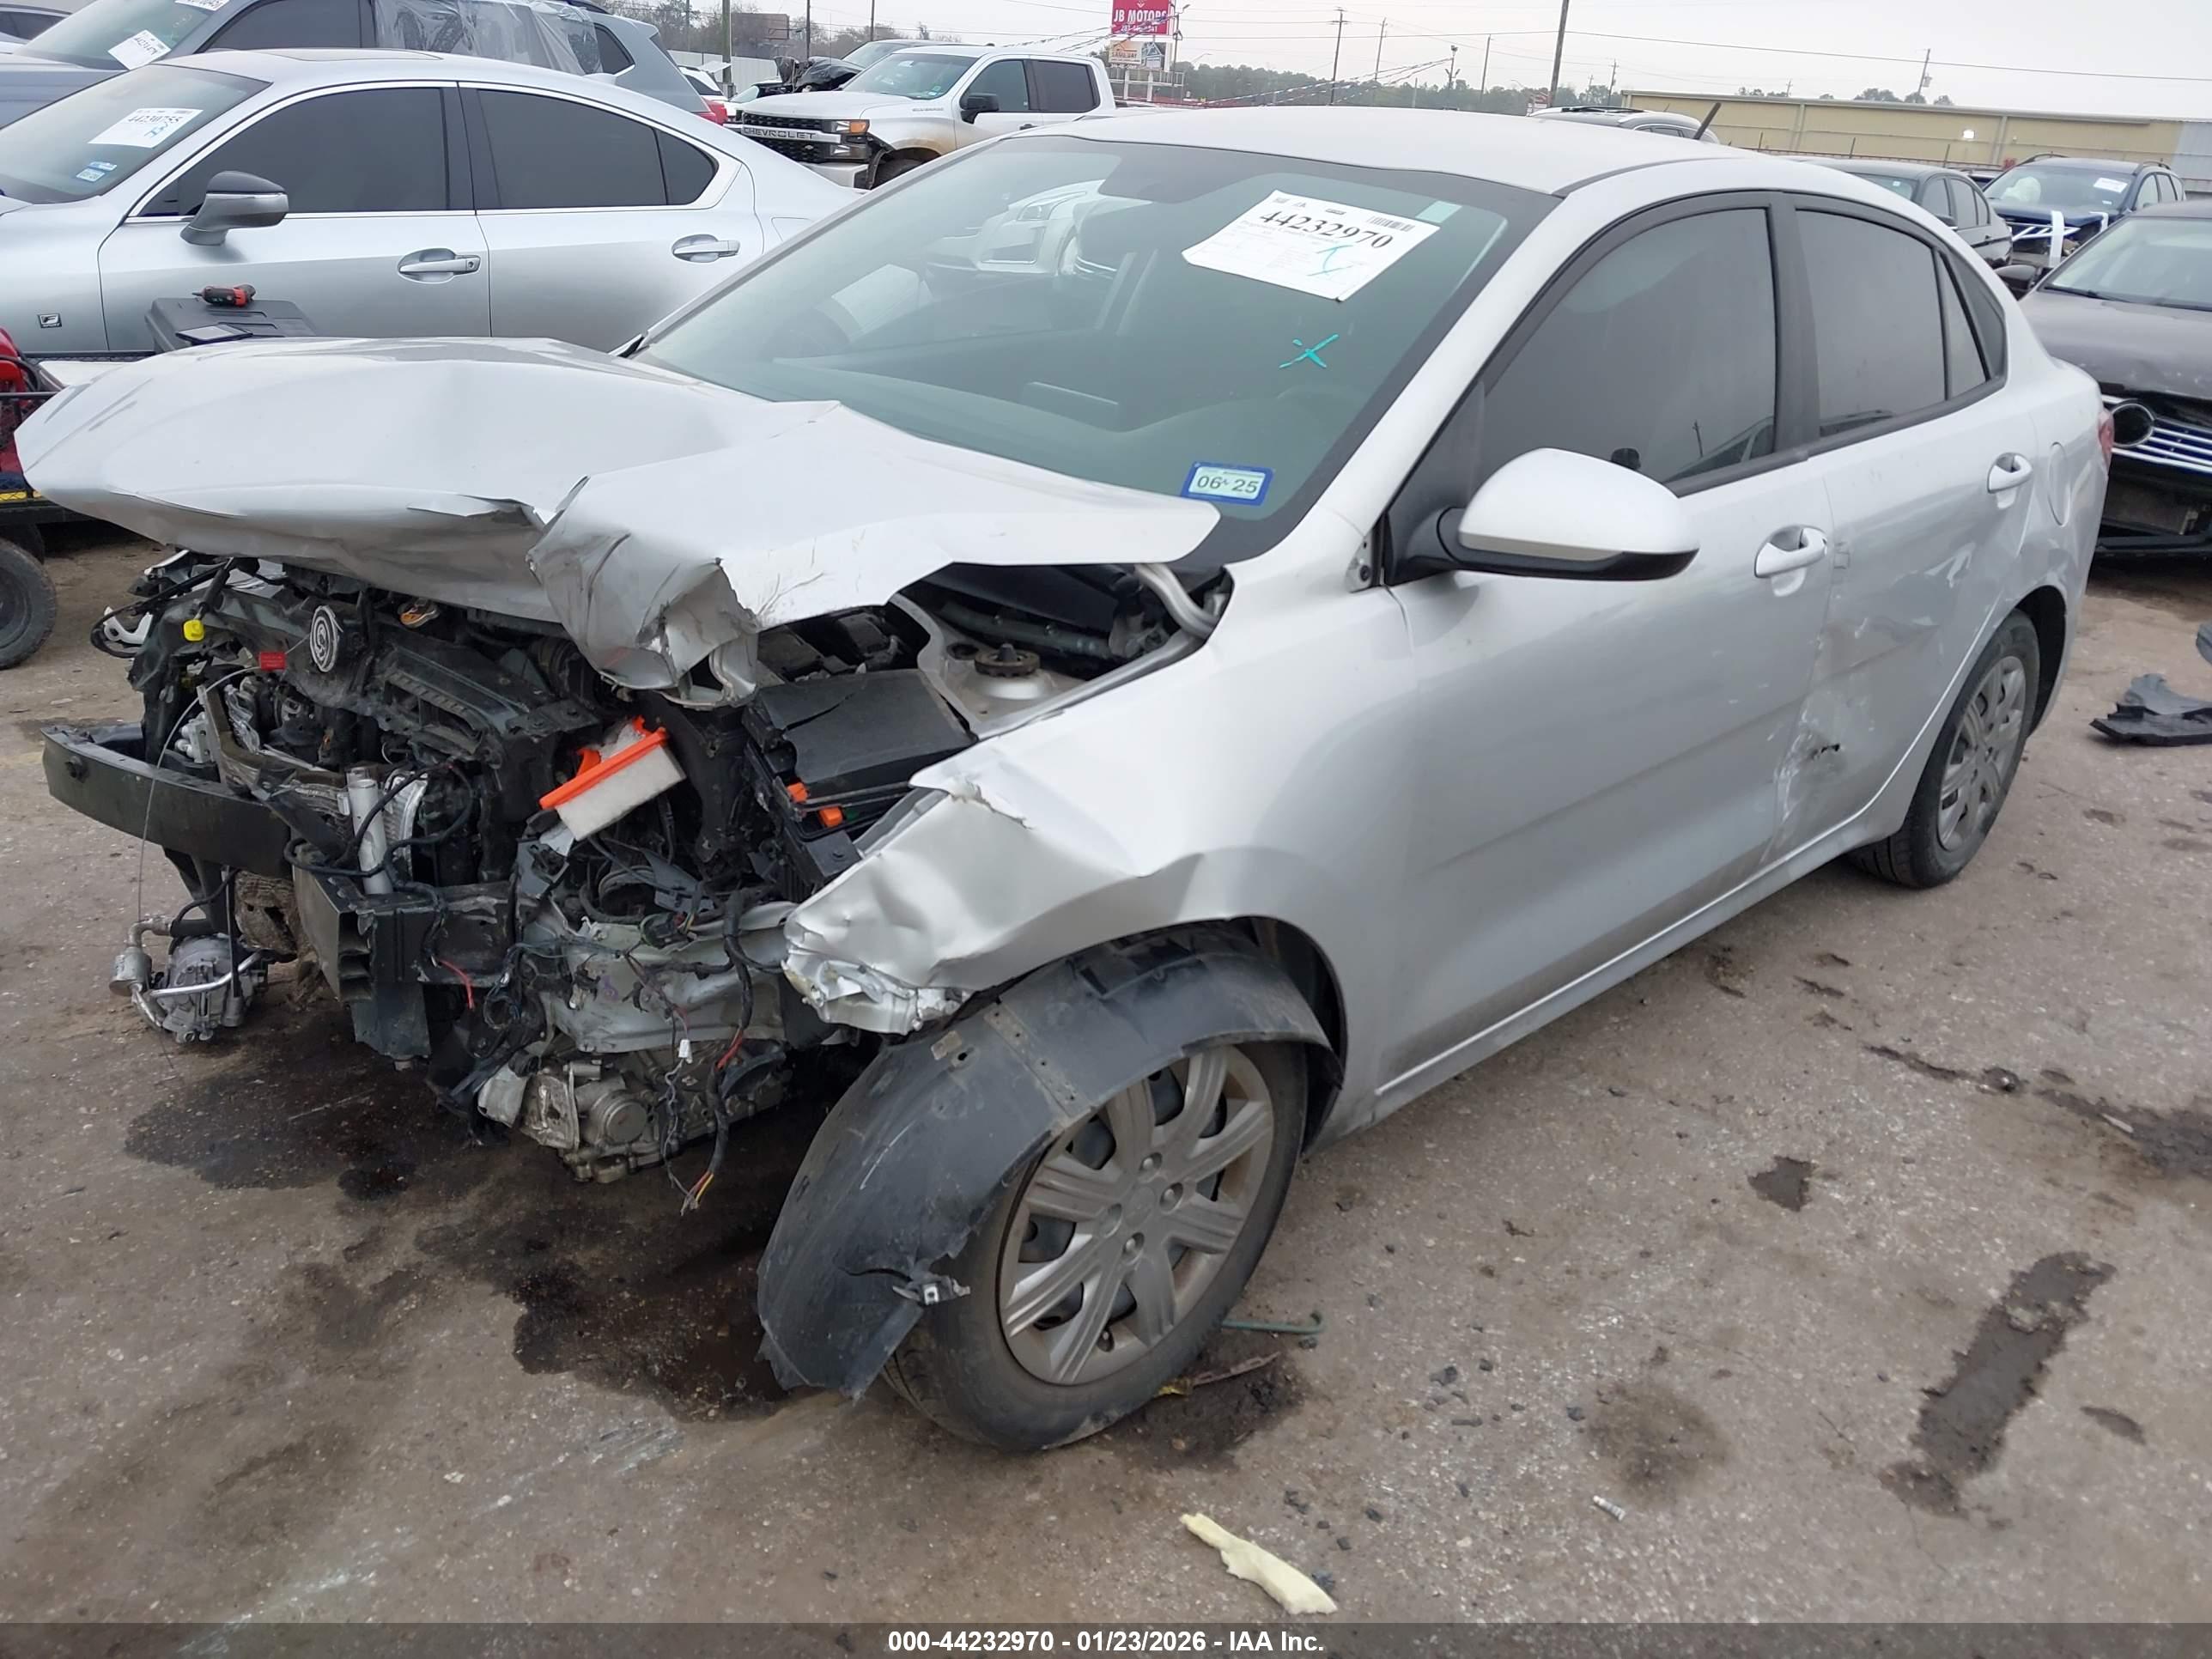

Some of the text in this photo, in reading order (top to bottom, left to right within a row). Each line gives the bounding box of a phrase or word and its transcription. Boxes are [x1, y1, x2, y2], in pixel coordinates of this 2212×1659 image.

[1114, 9, 1167, 23] JB MOTORS
[744, 127, 816, 140] CHEVROLET
[1260, 210, 1394, 249] 44232970
[1197, 476, 1259, 494] 06 25
